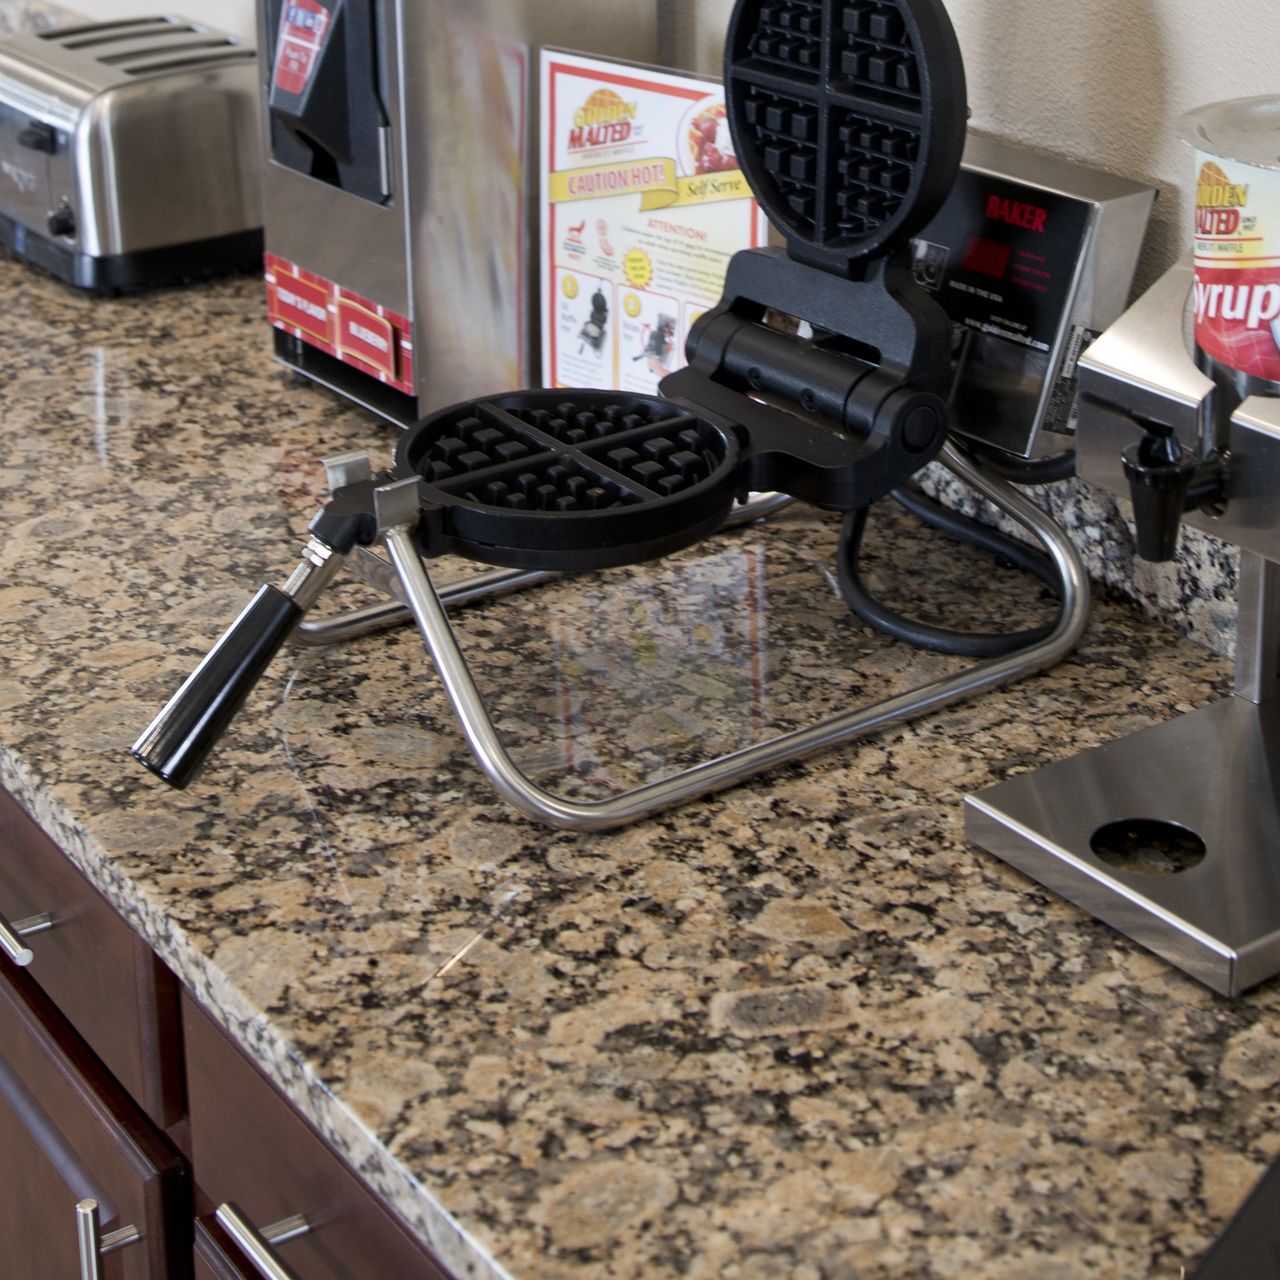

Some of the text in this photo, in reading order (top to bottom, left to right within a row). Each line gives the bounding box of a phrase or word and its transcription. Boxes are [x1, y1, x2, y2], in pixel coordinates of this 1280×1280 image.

[567, 120, 631, 149] MALTED
[567, 164, 665, 195] CAUTION HOT!
[686, 179, 742, 198] Self Serve
[986, 195, 1048, 233] BAKER
[648, 220, 708, 241] ATTENTION!
